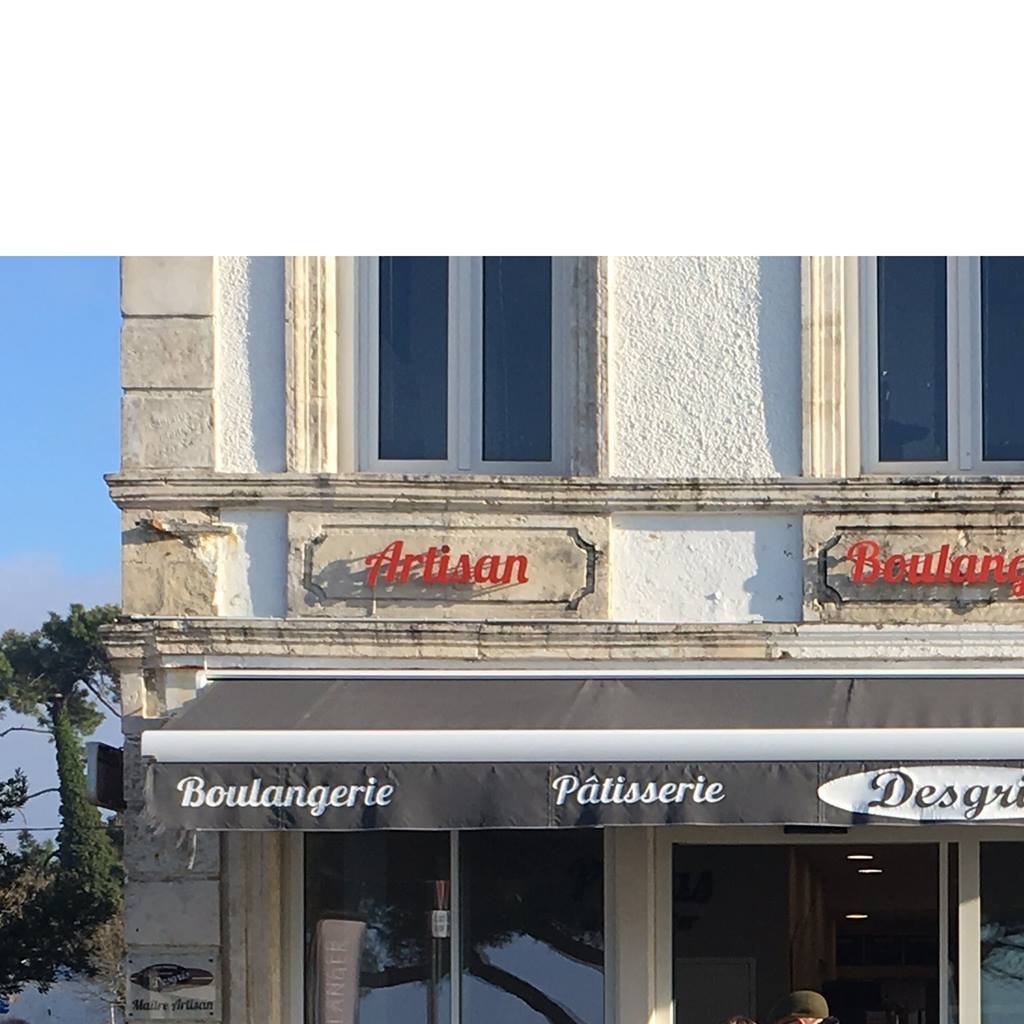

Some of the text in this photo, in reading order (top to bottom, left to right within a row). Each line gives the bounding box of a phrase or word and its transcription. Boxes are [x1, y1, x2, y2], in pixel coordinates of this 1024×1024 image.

[365, 540, 529, 586] Artisan
[176, 775, 394, 817] Boulangerie
[552, 774, 726, 806] Pâtisserie
[171, 998, 214, 1011] Artisan
